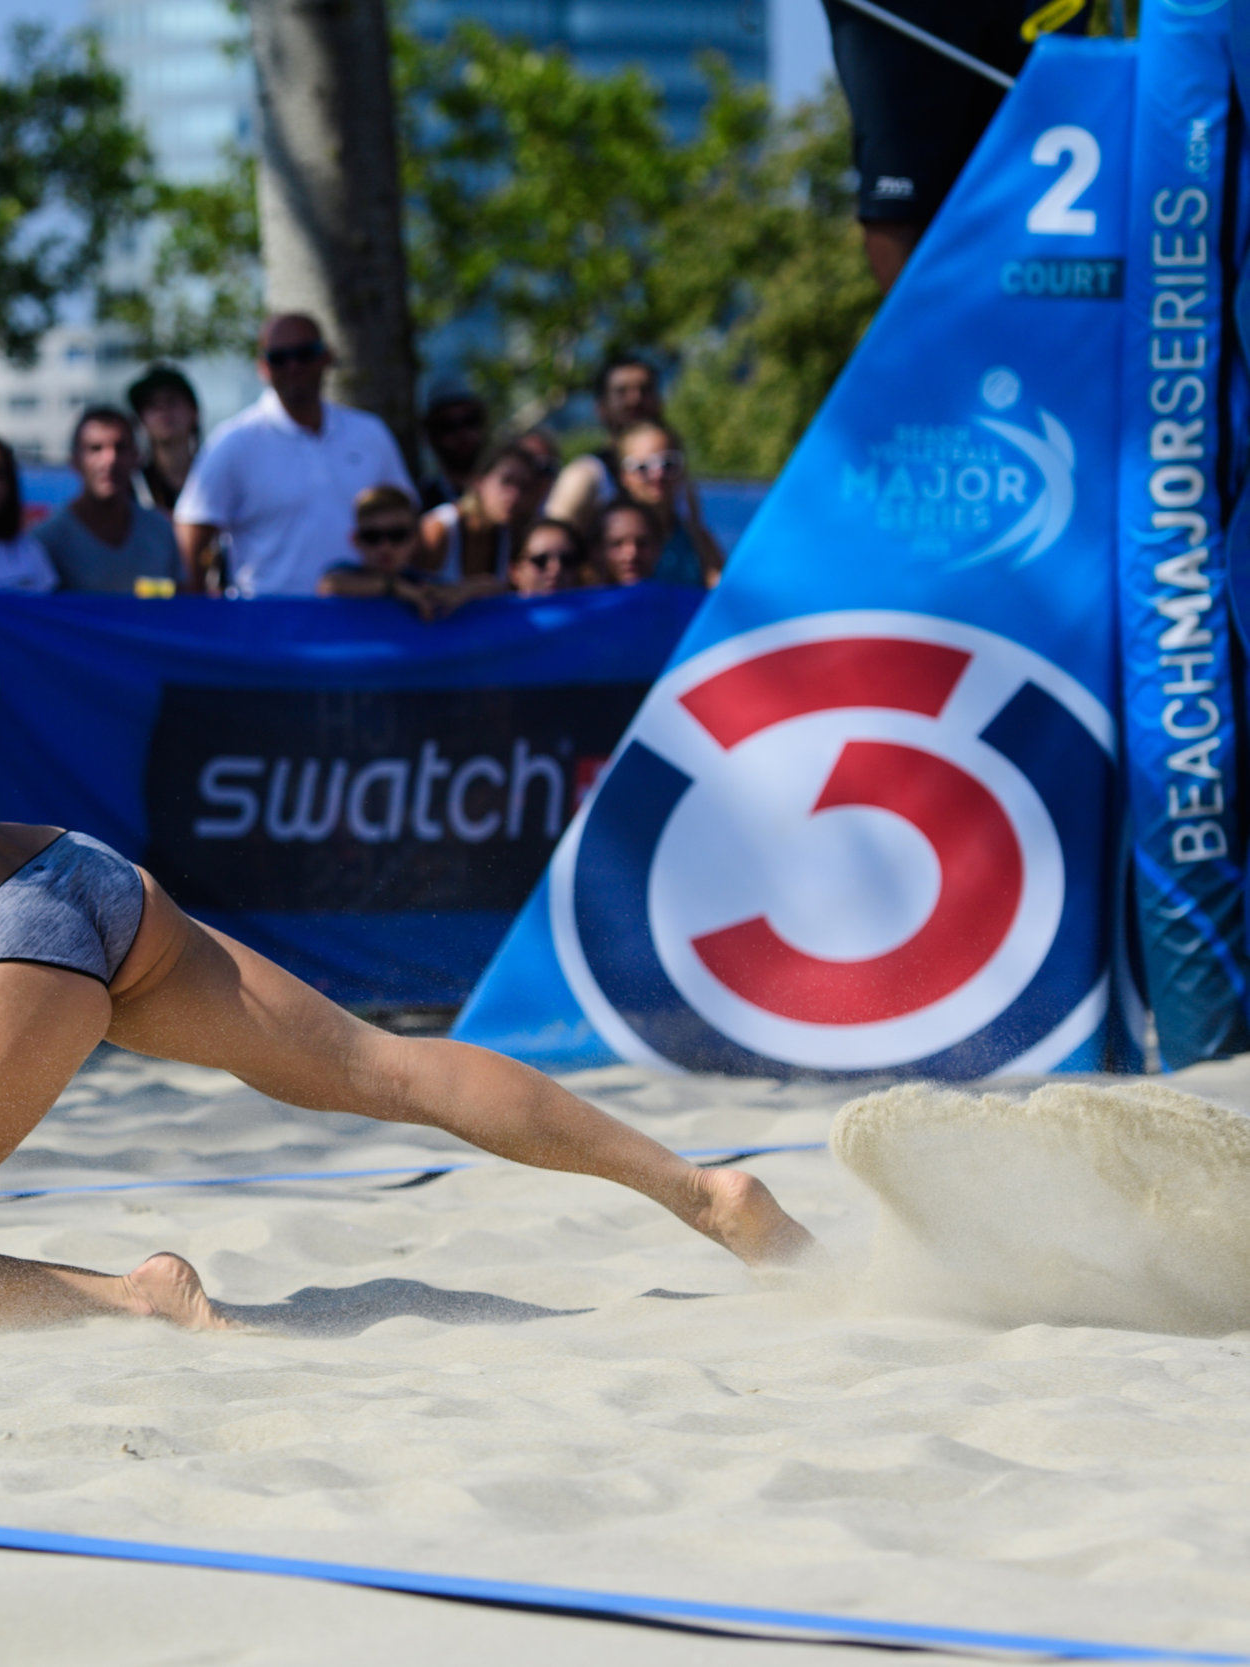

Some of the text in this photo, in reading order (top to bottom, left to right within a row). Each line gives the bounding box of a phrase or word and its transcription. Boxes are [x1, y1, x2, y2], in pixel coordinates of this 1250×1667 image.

[1026, 124, 1101, 236] 2
[1001, 260, 1117, 296] COURT
[841, 464, 1028, 505] MAJOR
[877, 503, 993, 532] SERIES
[193, 741, 566, 843] swatch
